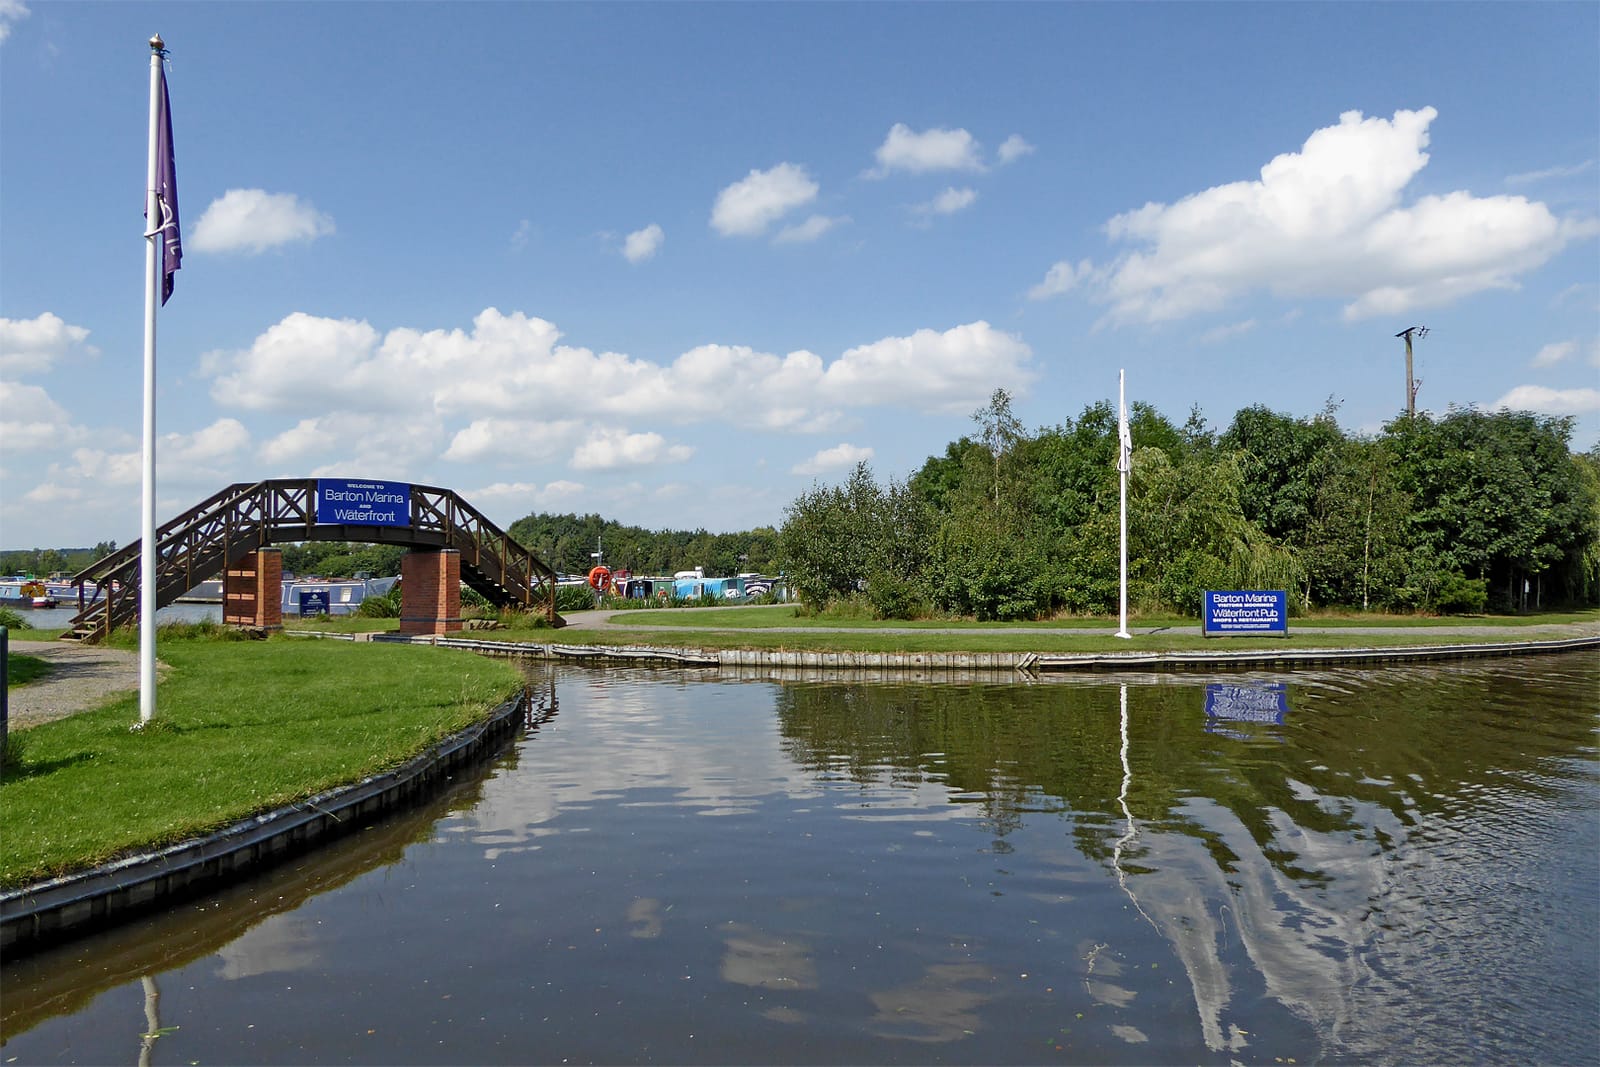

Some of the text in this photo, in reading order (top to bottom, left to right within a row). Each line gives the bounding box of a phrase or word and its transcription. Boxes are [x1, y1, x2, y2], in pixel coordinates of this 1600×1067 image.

[325, 489, 404, 504] Barton Marina
[334, 509, 396, 522] Waterfront
[1213, 594, 1277, 603] Barton Marina
[1213, 608, 1278, 617] Waterfront Pub
